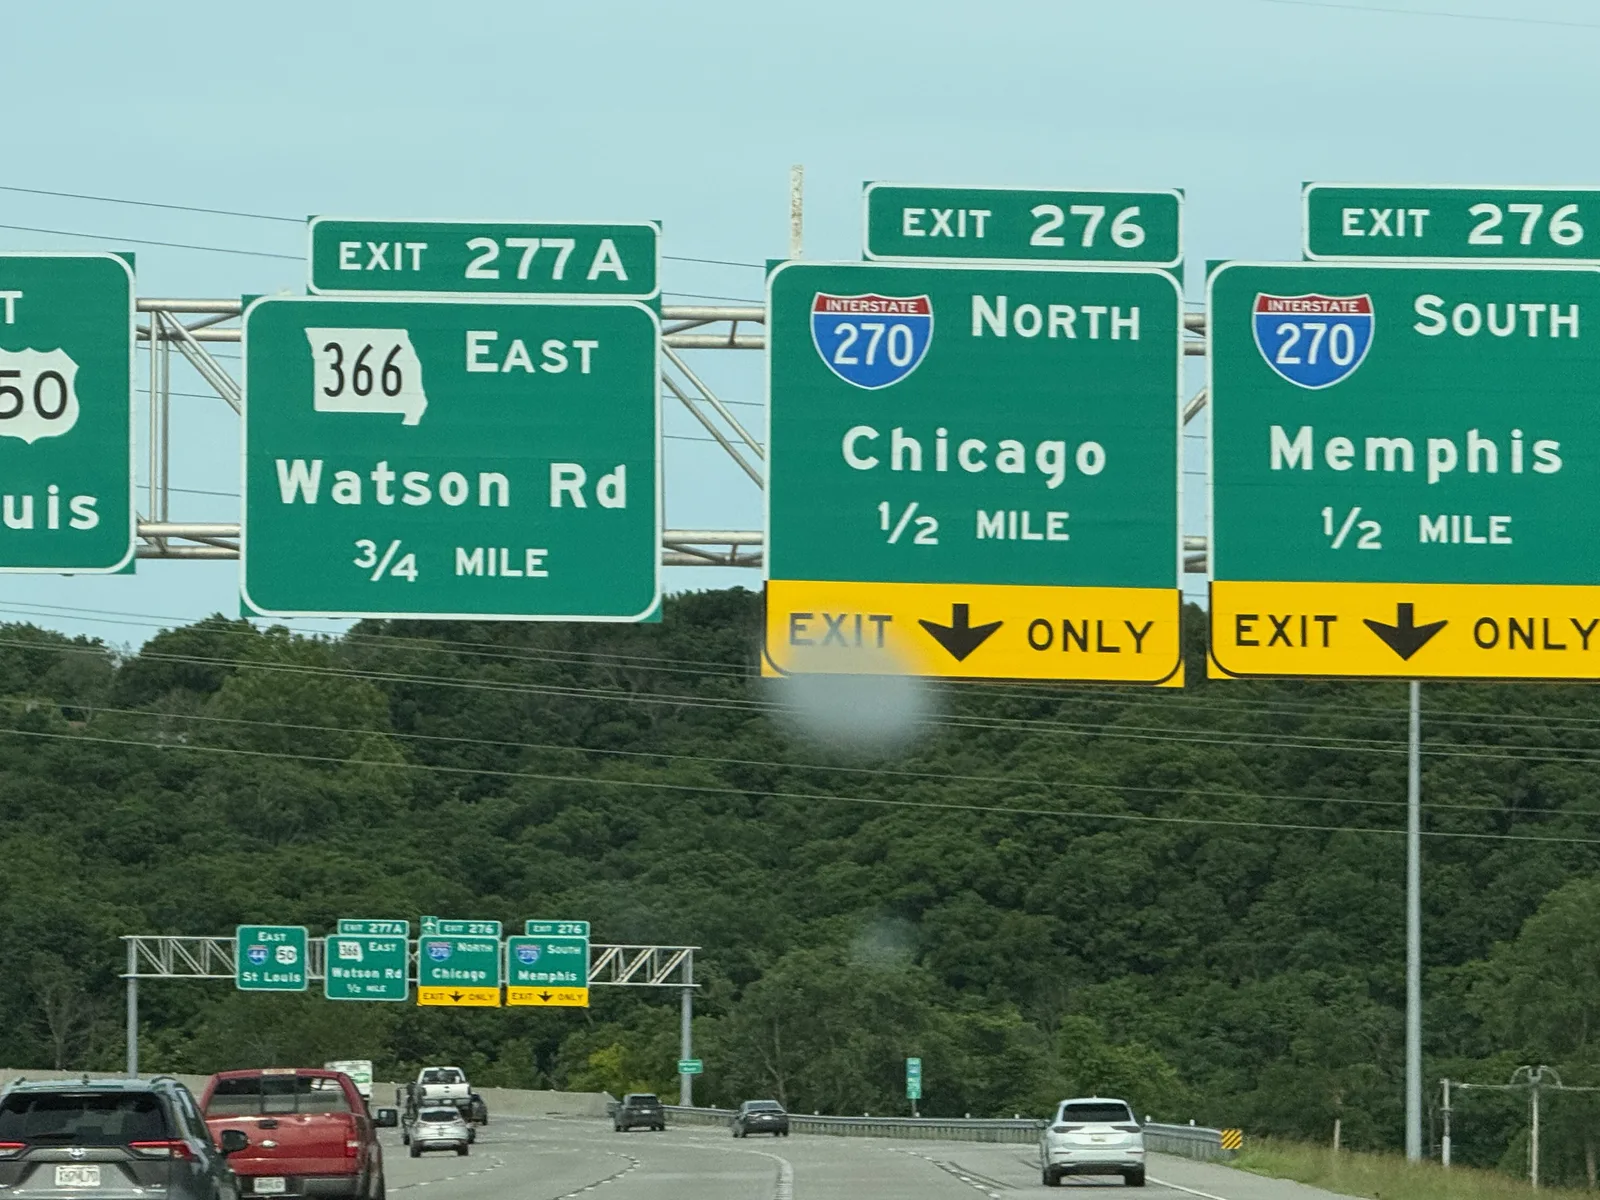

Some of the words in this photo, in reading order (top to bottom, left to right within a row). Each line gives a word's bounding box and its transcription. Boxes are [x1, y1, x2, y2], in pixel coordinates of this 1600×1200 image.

[904, 208, 991, 238] EXIT
[1030, 205, 1145, 248] 276
[1343, 208, 1430, 237] EXIT
[1468, 204, 1583, 245] 276
[340, 242, 427, 270] EXIT
[0, 291, 22, 323] T
[826, 300, 918, 313] INTERSTATE
[973, 295, 1139, 340] NORTH
[1267, 300, 1360, 313] INTERSTATE
[1414, 295, 1578, 337] SOUTH
[467, 331, 598, 373] EAST
[834, 323, 913, 366] 270
[1276, 322, 1355, 366] 270
[324, 342, 401, 397] 366
[0, 370, 67, 419] 50
[843, 426, 1105, 489] Chicago
[1271, 426, 1562, 484] Memphis
[276, 459, 509, 506] Watson
[551, 463, 626, 508] Rd
[977, 510, 1069, 540] MILE
[1420, 515, 1512, 544] MILE
[456, 548, 548, 577] MILE
[790, 613, 892, 647] EXIT
[1028, 619, 1153, 653] ONLY
[1236, 614, 1337, 647] EXIT
[1474, 617, 1600, 650] ONLY
[258, 931, 287, 942] EAST
[368, 923, 403, 933] 277A
[468, 924, 494, 934] 276
[557, 924, 583, 934] 276
[279, 949, 294, 960] 50
[368, 941, 397, 952] EAST
[242, 971, 258, 982] St
[263, 971, 301, 983] Louis
[332, 967, 379, 978] Watson
[384, 968, 403, 979] Rd
[432, 968, 486, 981] Chicago
[518, 971, 577, 981] Memphis
[422, 992, 445, 1001] EXIT
[468, 993, 495, 1001] ONLY
[511, 992, 534, 1001] EXIT
[557, 993, 584, 1001] ONLY
